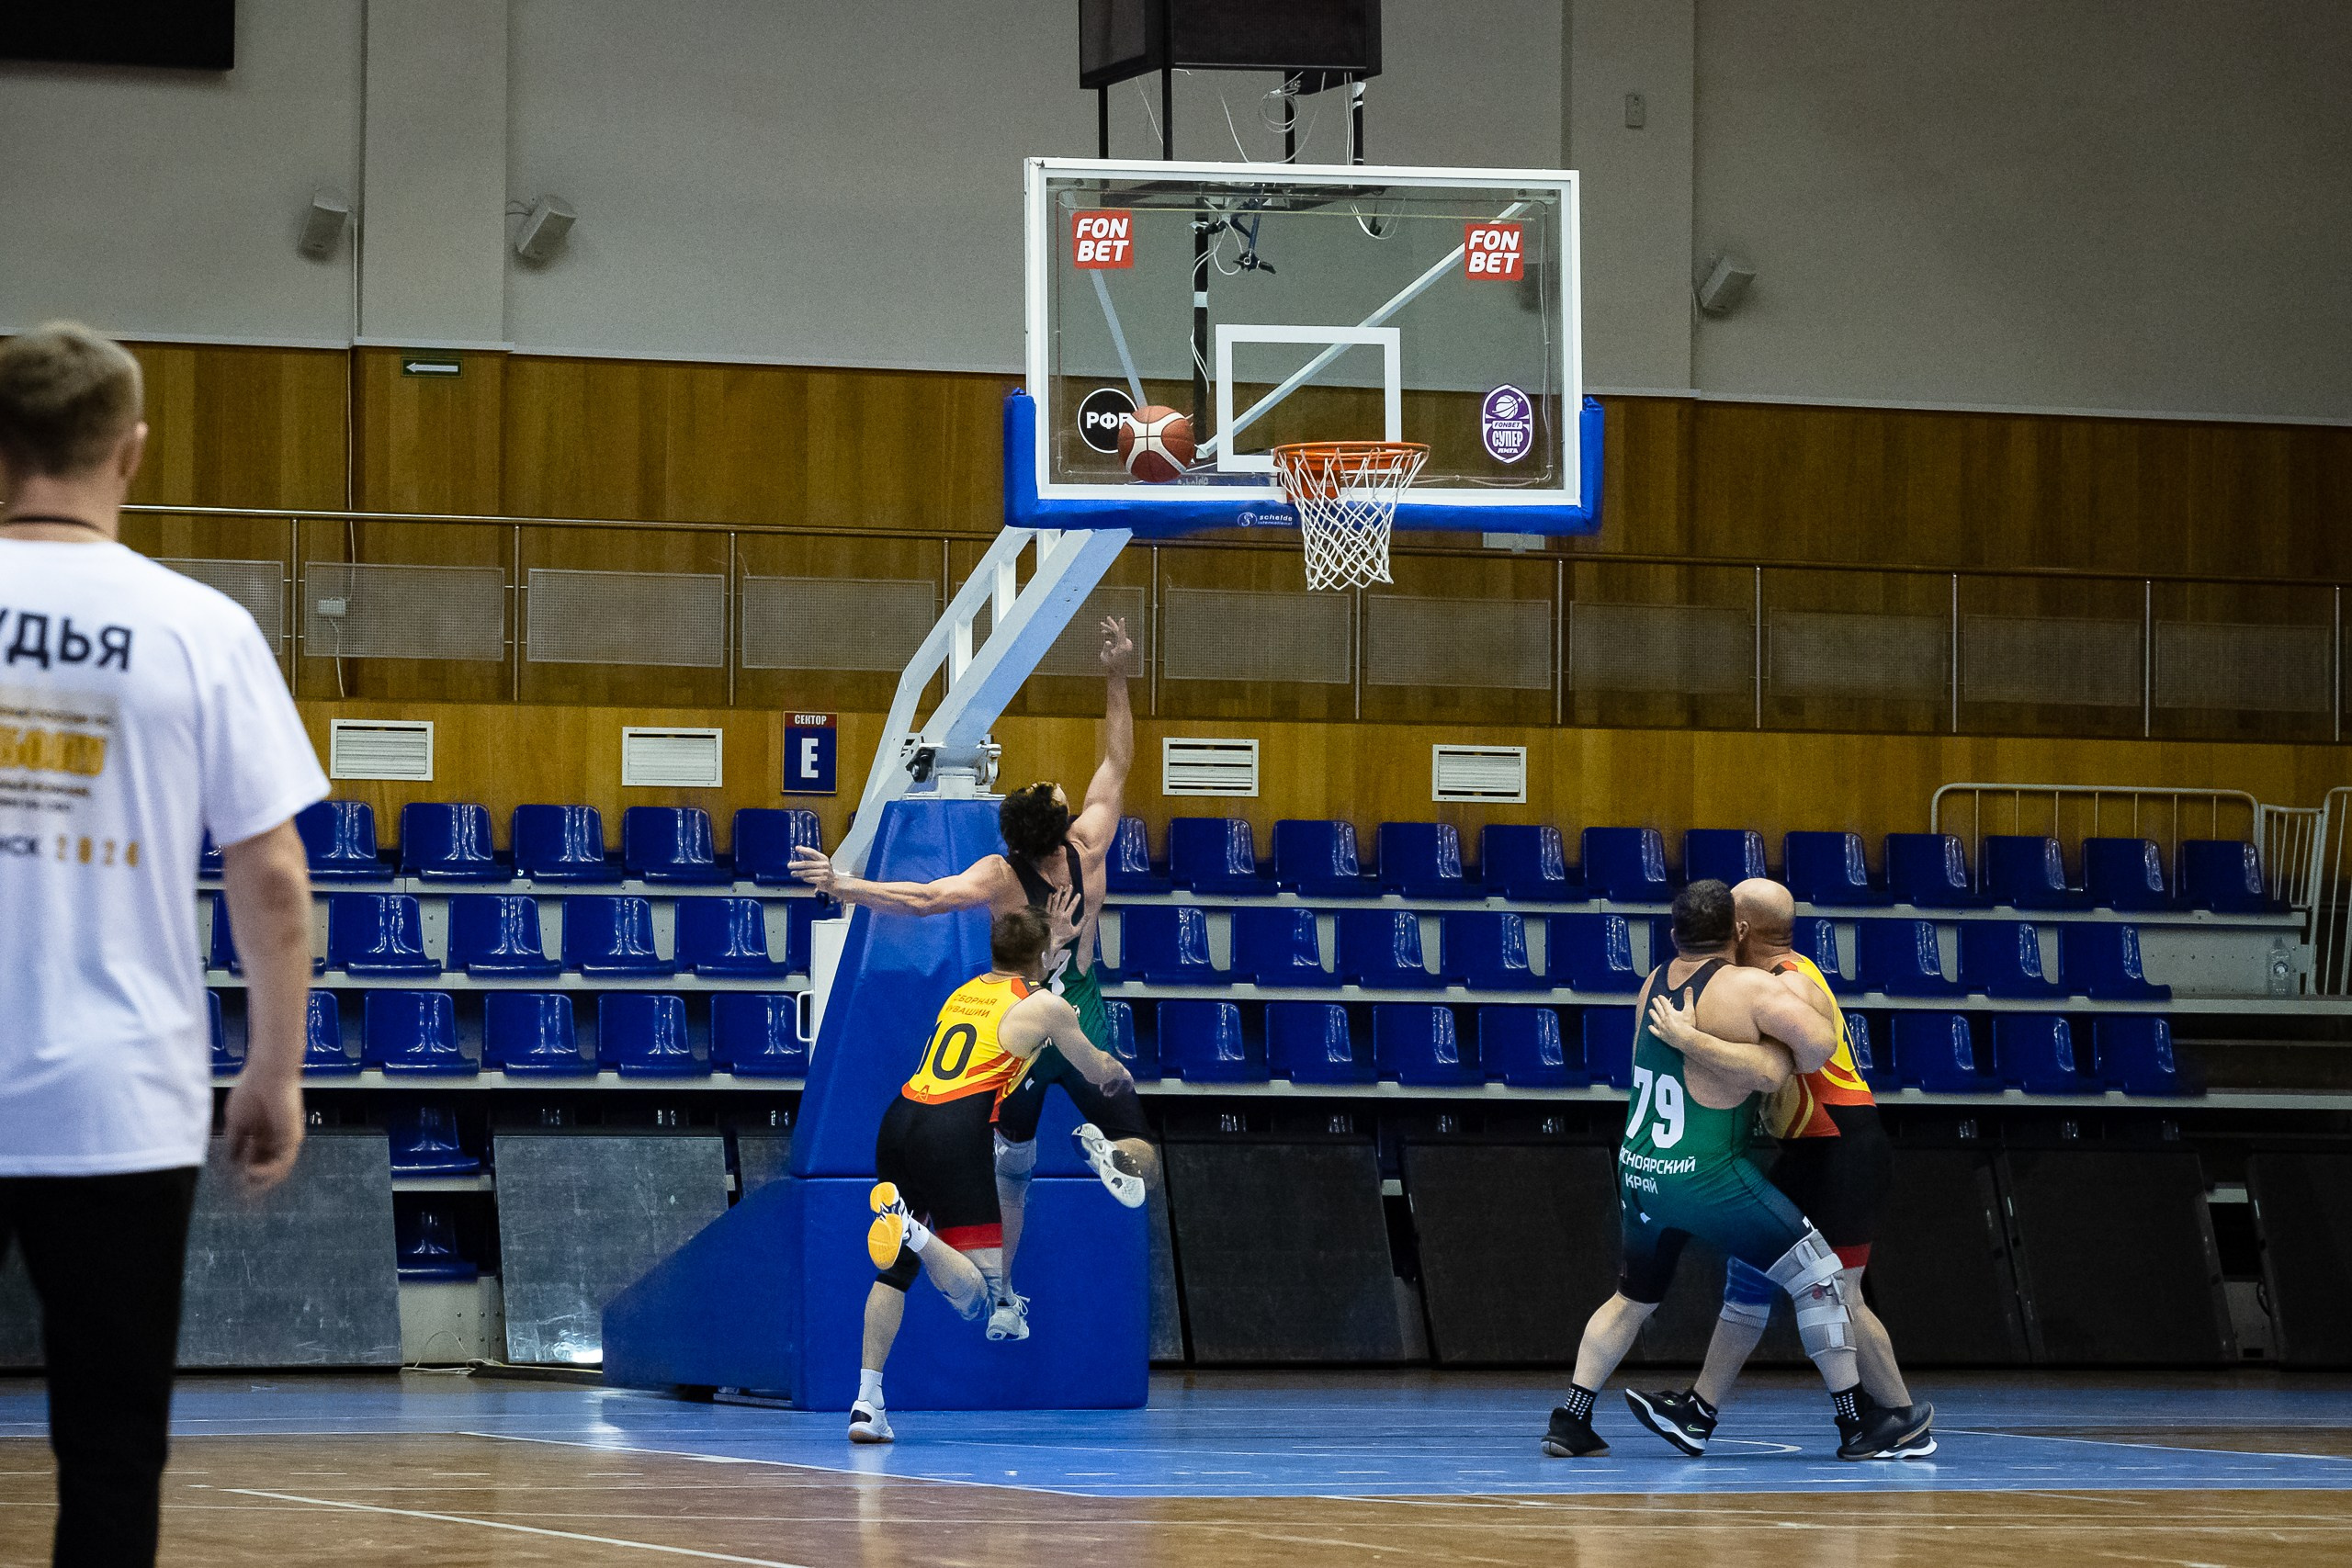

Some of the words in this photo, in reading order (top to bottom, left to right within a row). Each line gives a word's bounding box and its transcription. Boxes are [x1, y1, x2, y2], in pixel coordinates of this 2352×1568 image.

[1076, 218, 1129, 239] FON
[1077, 240, 1130, 262] BET
[1468, 230, 1521, 251] FON
[1468, 251, 1521, 274] BET
[1492, 430, 1523, 447] СУПЕР
[0, 608, 132, 671] ДЬЯ
[794, 714, 827, 725] СЕКТОР
[953, 994, 998, 1006] СБОРНАЯ
[1625, 1065, 1685, 1148] 79
[1624, 1172, 1658, 1194] КРАЙ
